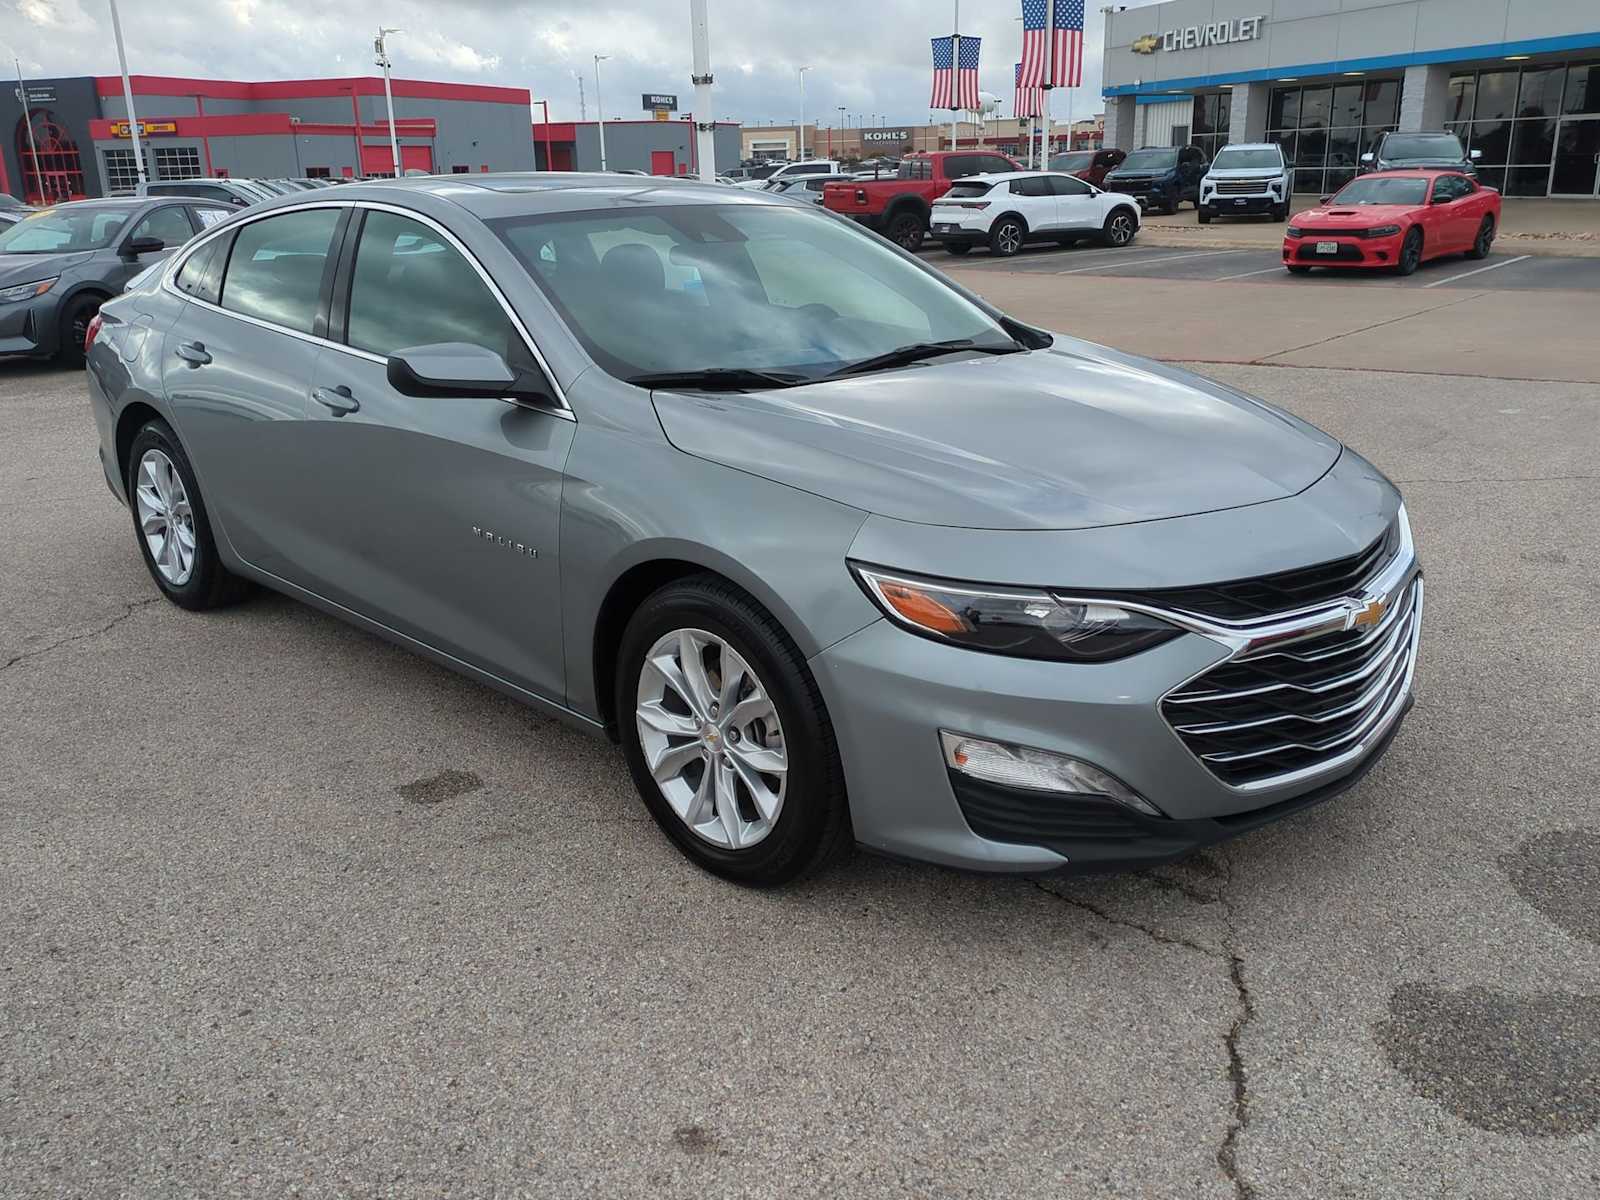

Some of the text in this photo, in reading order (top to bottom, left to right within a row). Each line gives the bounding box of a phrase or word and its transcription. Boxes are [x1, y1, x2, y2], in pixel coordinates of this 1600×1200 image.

[1163, 15, 1264, 52] CHEVROLET
[863, 131, 908, 141] KOHL'S
[472, 526, 538, 559] MALIBU
